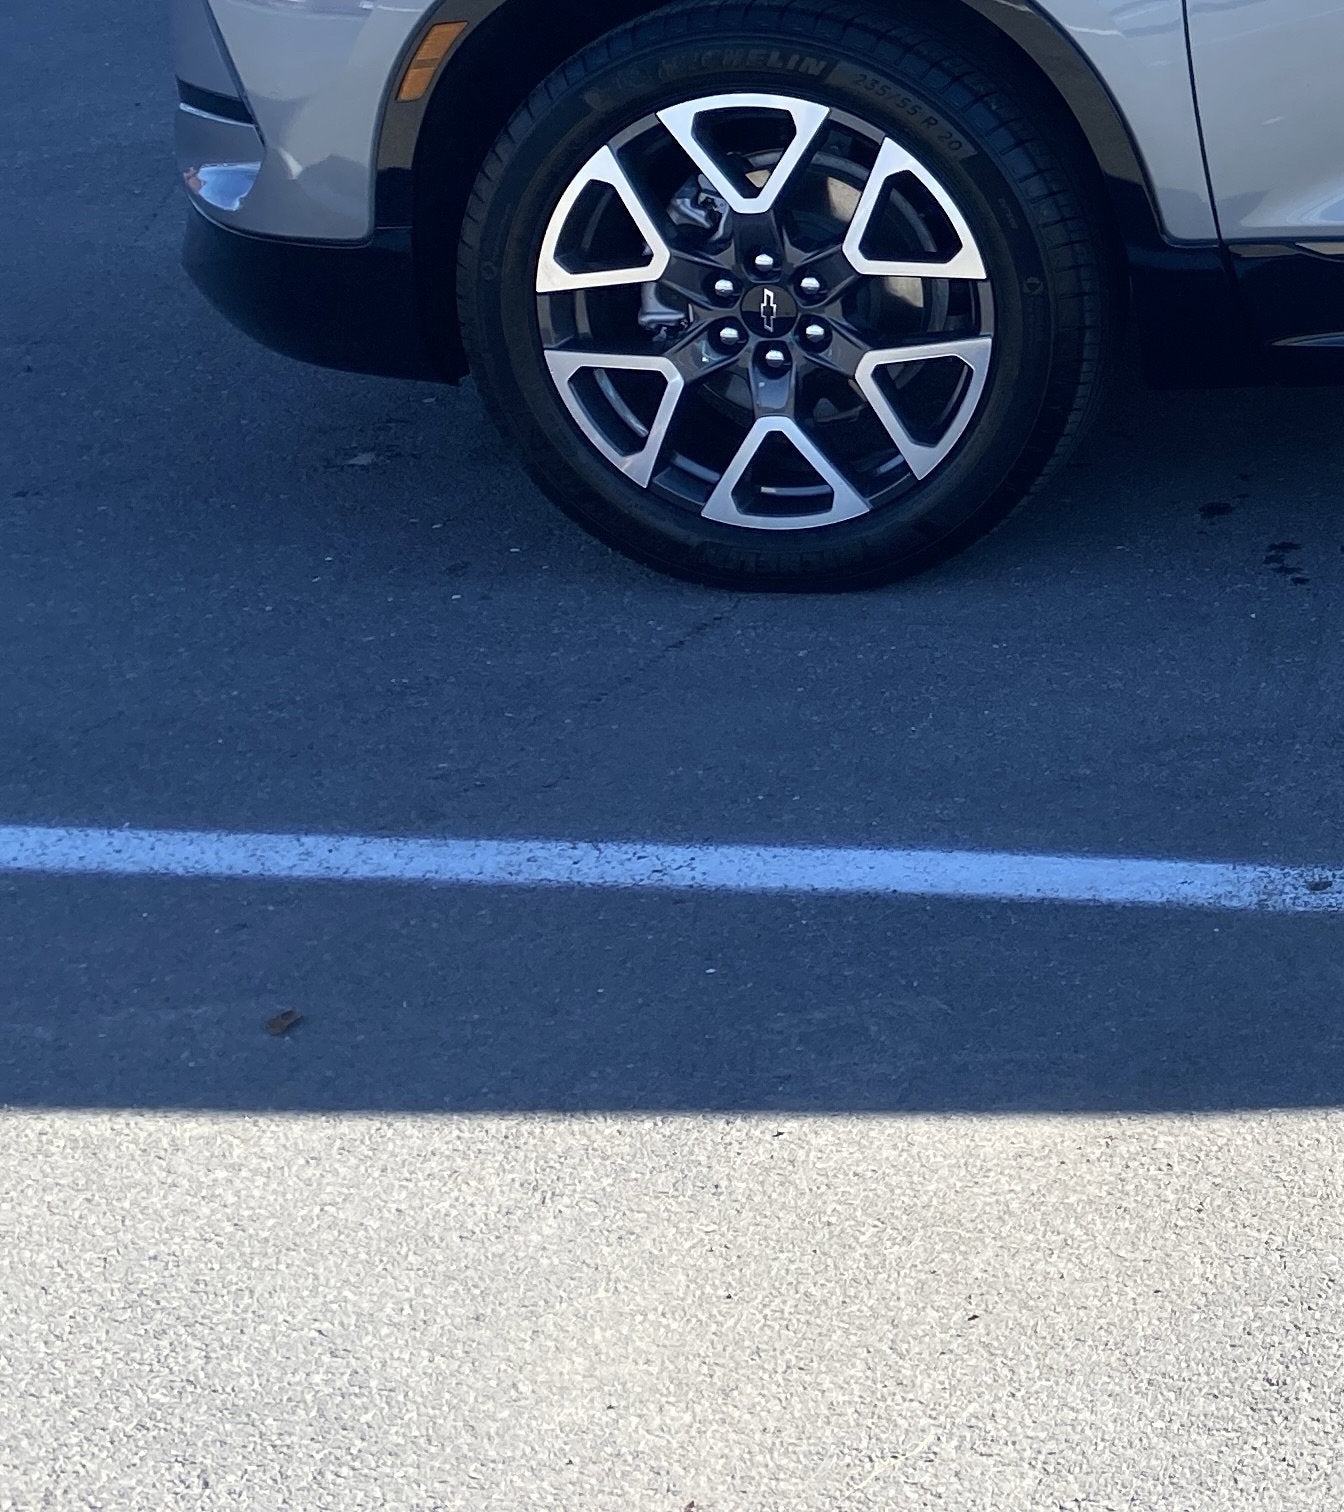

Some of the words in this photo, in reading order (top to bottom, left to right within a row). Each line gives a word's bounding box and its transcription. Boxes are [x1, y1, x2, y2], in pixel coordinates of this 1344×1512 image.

[655, 47, 827, 81] MICHELIN
[853, 72, 921, 119] 235/55
[925, 115, 938, 131] R
[939, 130, 963, 153] 20
